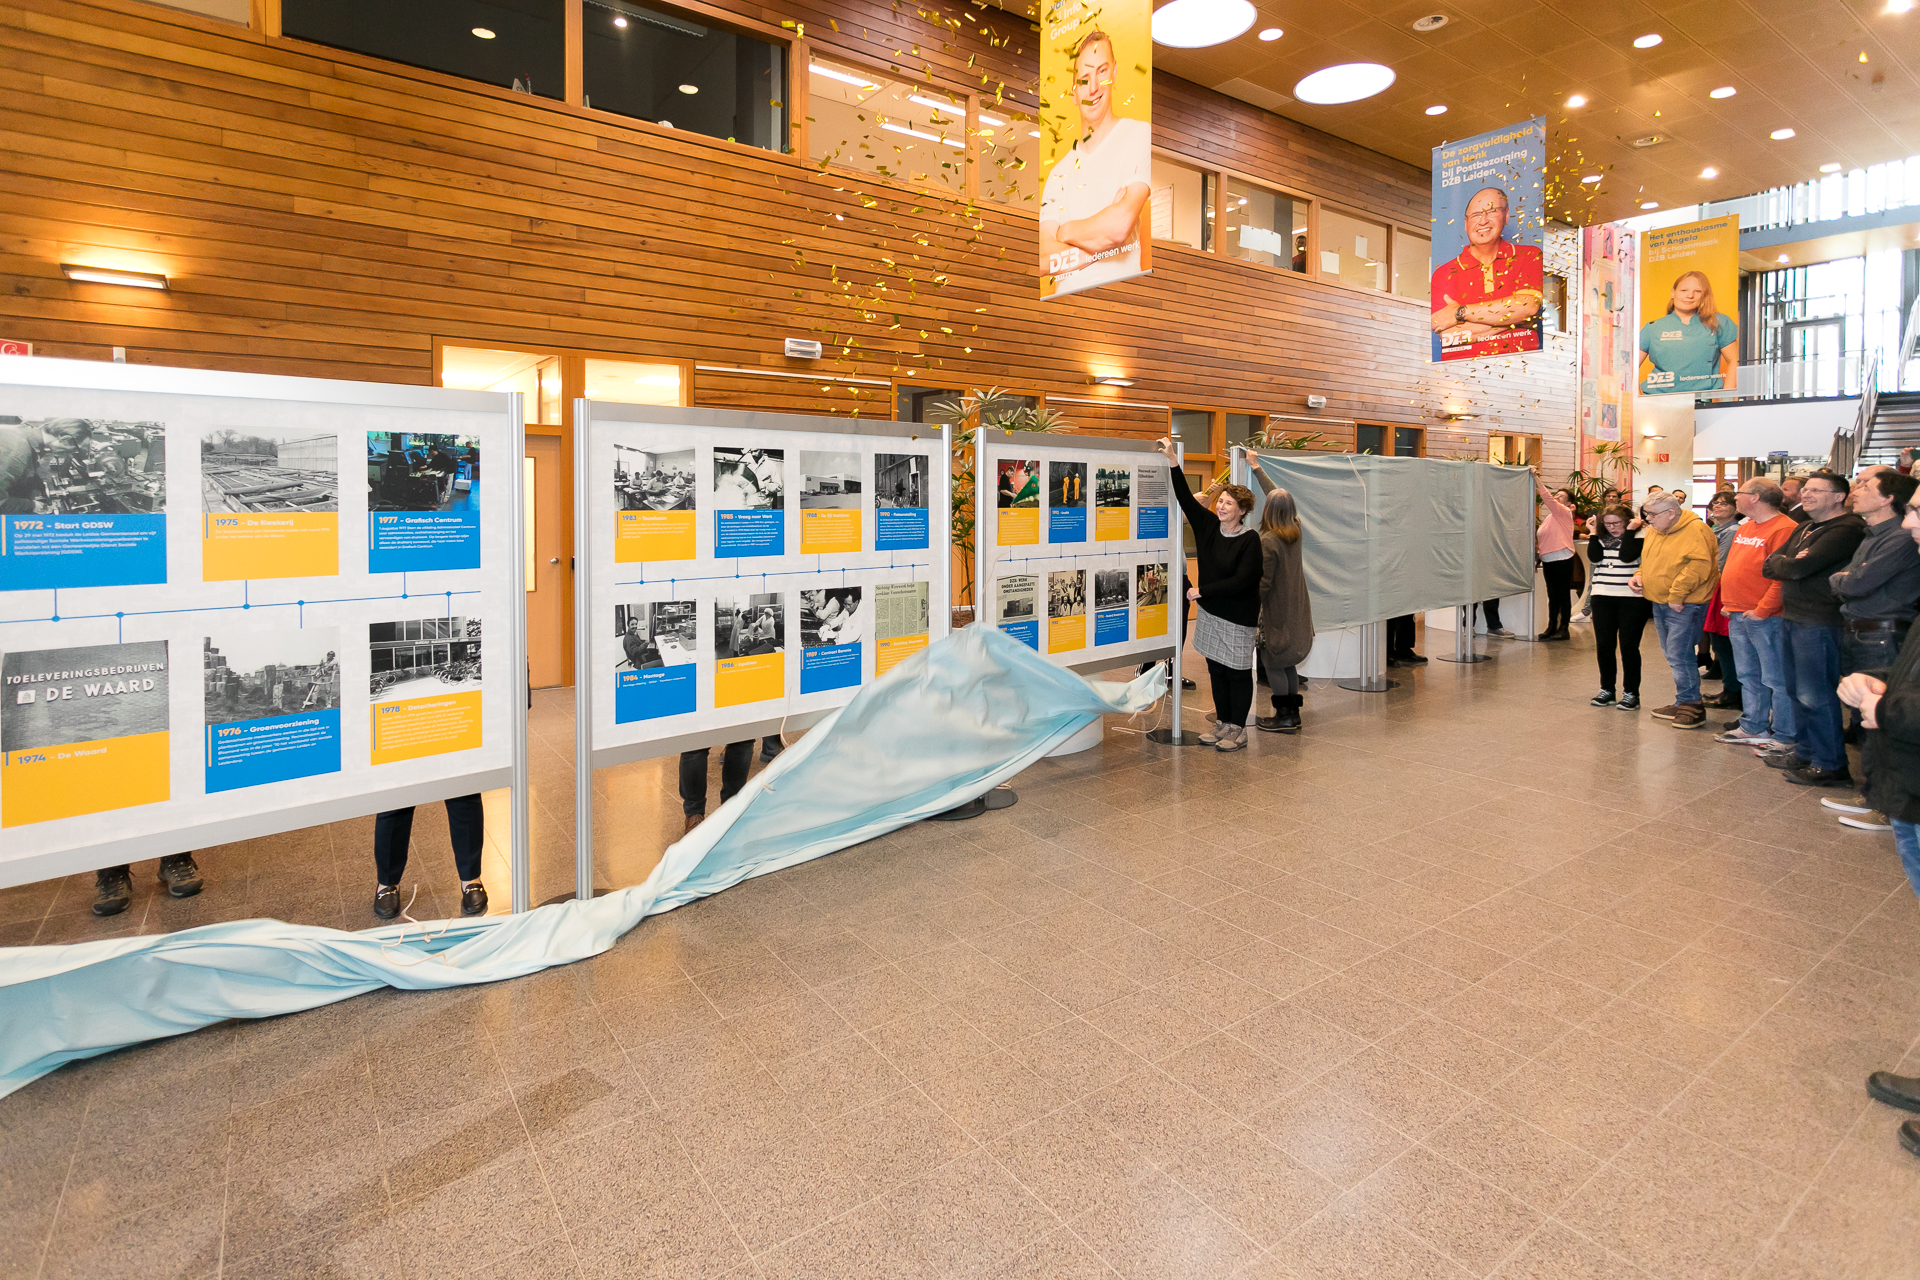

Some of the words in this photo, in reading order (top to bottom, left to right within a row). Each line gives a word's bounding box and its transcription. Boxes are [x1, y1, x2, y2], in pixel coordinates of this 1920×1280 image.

[1050, 18, 1080, 40] Group
[1442, 151, 1455, 159] De
[1458, 126, 1533, 155] zorgvuldigheid
[1442, 159, 1459, 169] van
[1462, 151, 1487, 163] Henk
[1442, 169, 1453, 179] bij
[1456, 149, 1527, 175] Postbezorging
[1442, 177, 1461, 188] DZB
[1463, 168, 1496, 182] Leiden
[1666, 222, 1728, 238] enthousiasme
[1649, 248, 1659, 256] bij
[1661, 238, 1719, 254] Schoonmaak
[1667, 235, 1698, 245] Angela
[1049, 247, 1079, 274] DZB
[1085, 251, 1119, 263] Iedereen
[1120, 240, 1140, 253] werk
[1649, 255, 1665, 263] DZB
[1667, 250, 1696, 259] Leiden
[1441, 330, 1472, 347] DZB
[1513, 329, 1532, 338] werk
[1661, 330, 1683, 338] DZB
[1647, 371, 1675, 384] DZB
[13, 521, 44, 530] 1972
[260, 519, 294, 527] Kwekerij
[379, 516, 398, 524] 1977
[6, 662, 165, 685] TOELEVERINGSBEDRIJVEN
[46, 686, 73, 702] DE
[84, 678, 155, 697] WAARD
[381, 706, 400, 714] 1978
[408, 700, 457, 711] Detacheringen
[218, 727, 241, 737] 1976
[250, 718, 320, 733] Groenvoorziening
[18, 754, 46, 765] 1974
[58, 752, 71, 760] De
[74, 747, 107, 758] Waard
